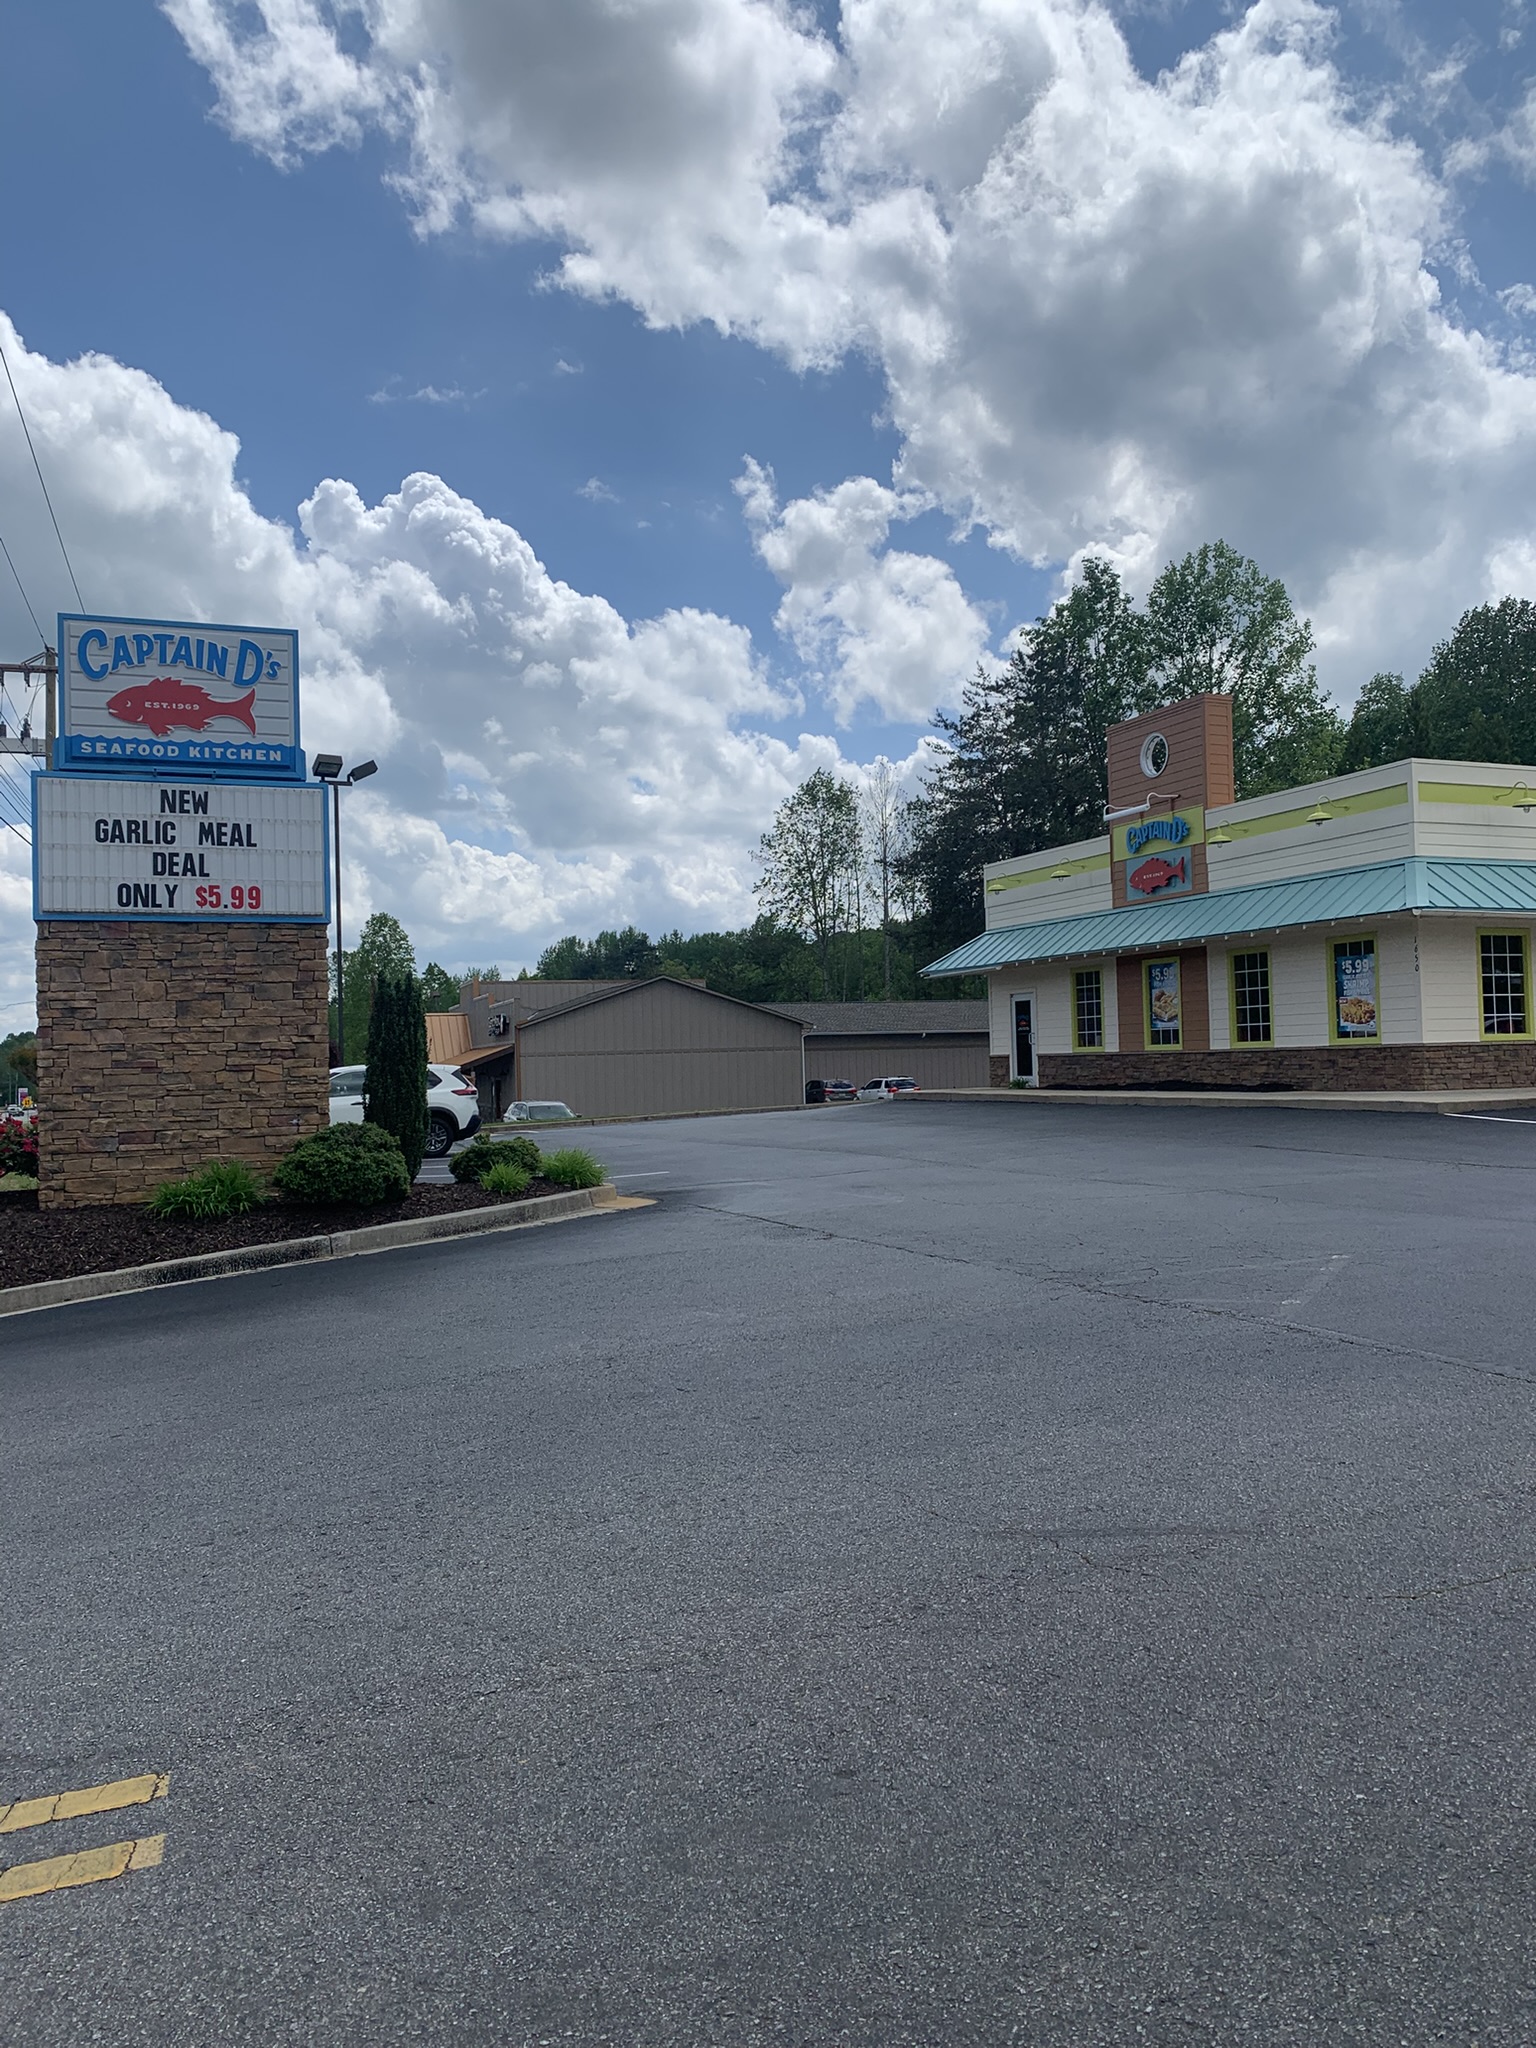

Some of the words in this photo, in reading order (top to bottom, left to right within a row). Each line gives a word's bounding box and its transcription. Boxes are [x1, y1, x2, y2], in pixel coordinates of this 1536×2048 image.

[77, 628, 229, 681] CAPTAIN
[80, 741, 180, 758] SEAFOOD
[189, 746, 282, 762] KITCHEN
[160, 789, 209, 814] NEW
[95, 818, 176, 845] GARLIC
[198, 822, 257, 847] MEAL
[1126, 820, 1171, 854] CAPTAIN
[152, 852, 210, 877] DEAL
[117, 883, 178, 908] ONLY
[195, 884, 261, 910] $5.99
[1341, 959, 1369, 974] $5.99
